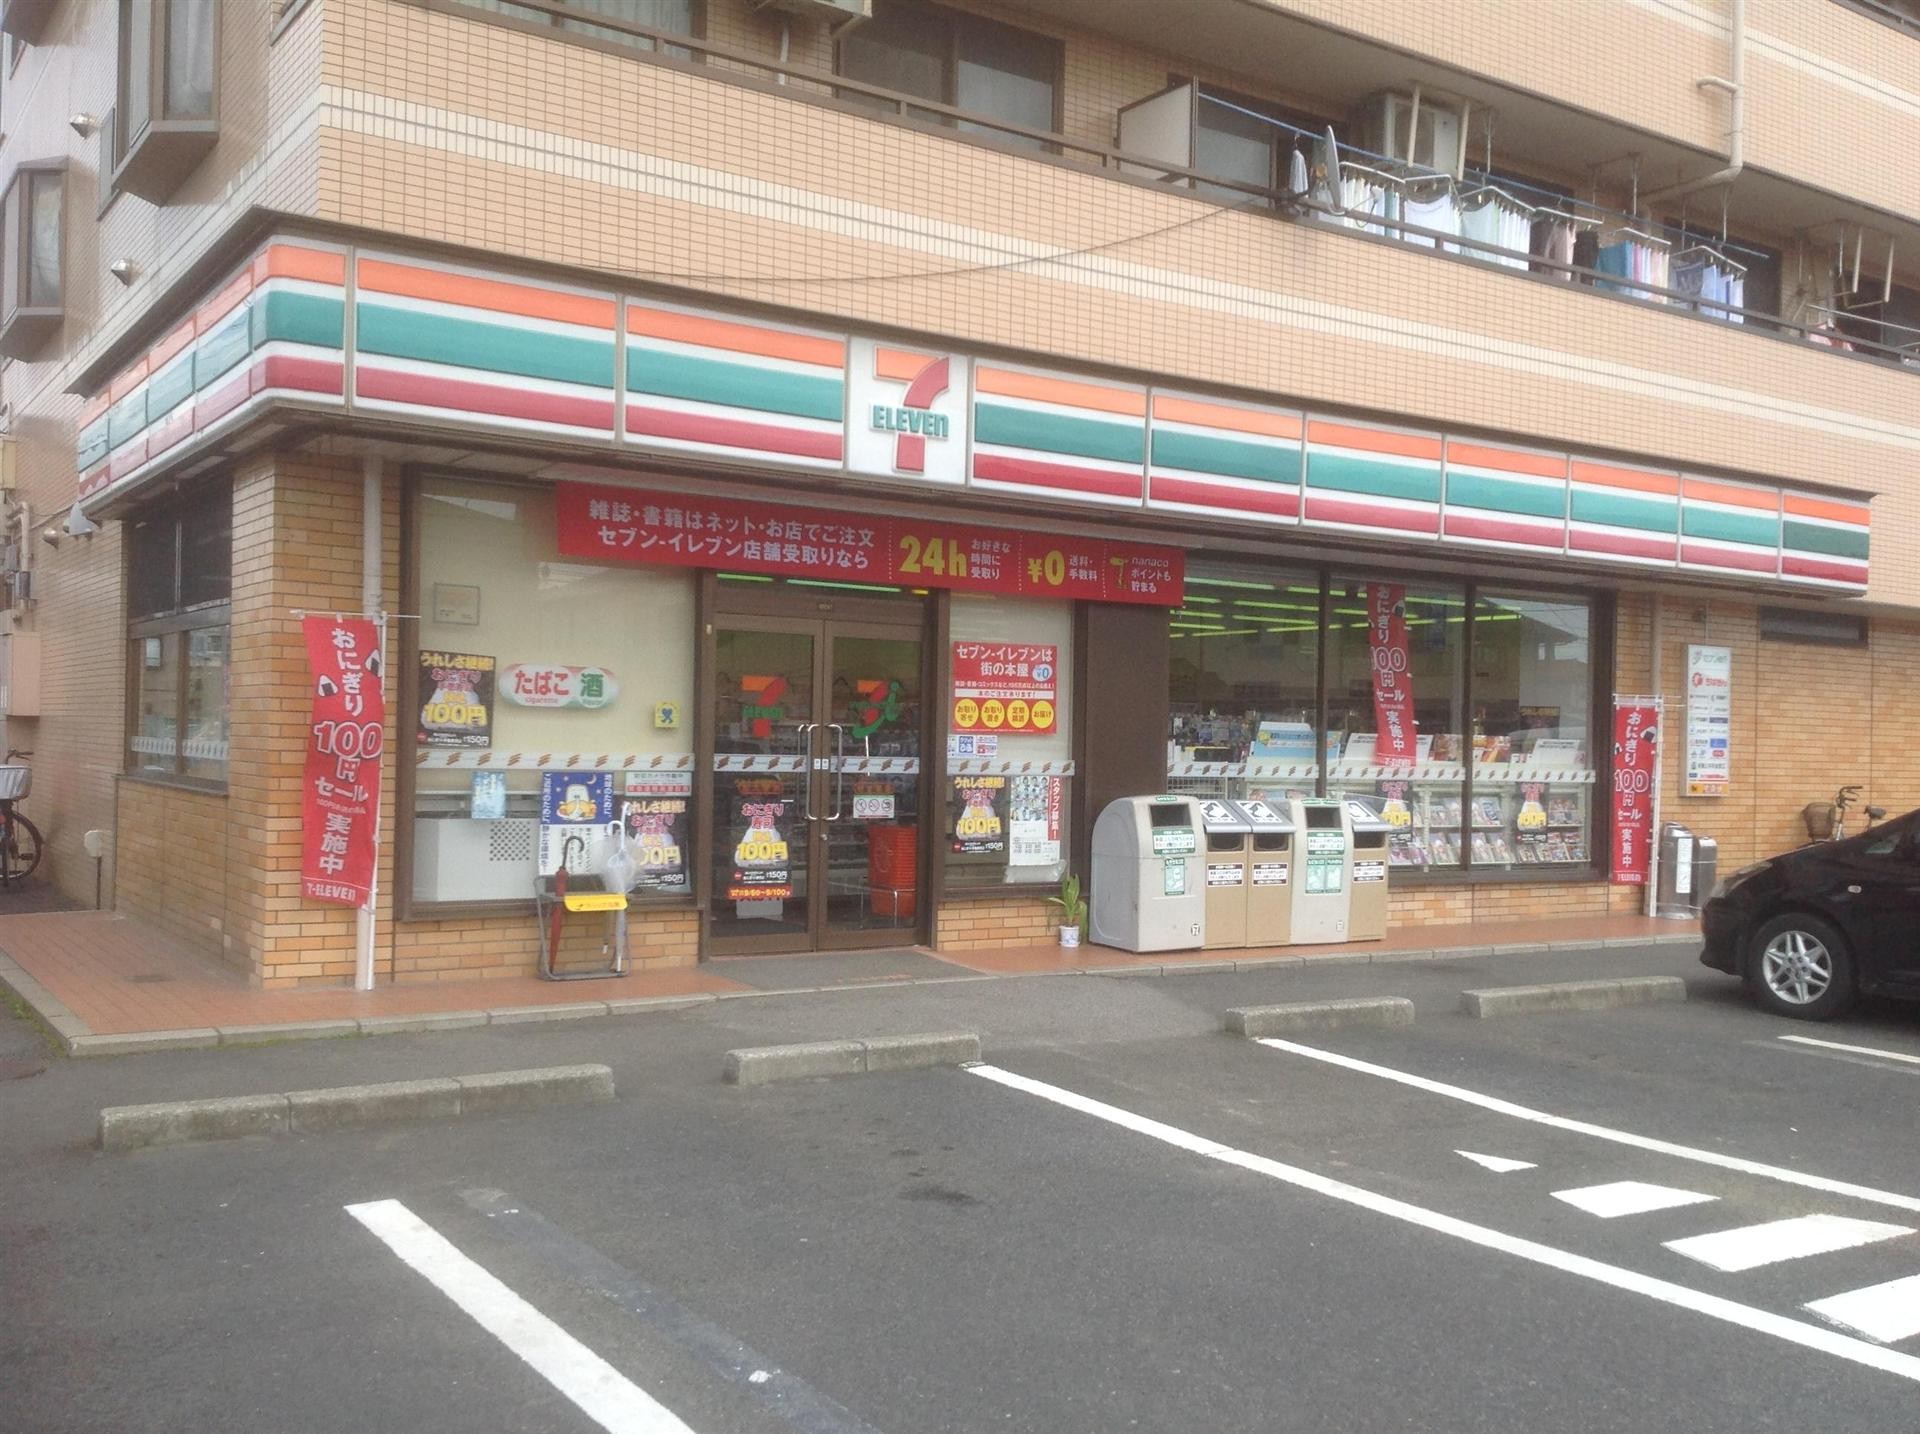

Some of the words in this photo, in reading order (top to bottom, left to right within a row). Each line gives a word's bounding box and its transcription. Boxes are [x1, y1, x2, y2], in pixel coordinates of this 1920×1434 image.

[899, 535, 968, 577] 24h
[971, 538, 1011, 554] お好きな
[970, 553, 1001, 567] 時間に
[1026, 550, 1065, 586] ¥0
[1131, 556, 1169, 568] nanaco
[1375, 586, 1391, 644] おにぎり
[956, 644, 1054, 662] セブン-イレブンは
[331, 627, 364, 717] おにぎり
[980, 661, 1029, 678] 街の本屋
[514, 669, 570, 697] たばこ
[580, 672, 604, 699] 酒
[313, 719, 385, 759] 100
[1625, 711, 1642, 767] おにぎり
[335, 759, 362, 783] 円
[1614, 768, 1650, 793] 100
[314, 776, 370, 804] セール
[741, 802, 785, 817] おにぎり
[318, 812, 354, 876] 実施中
[736, 841, 789, 862] 100円
